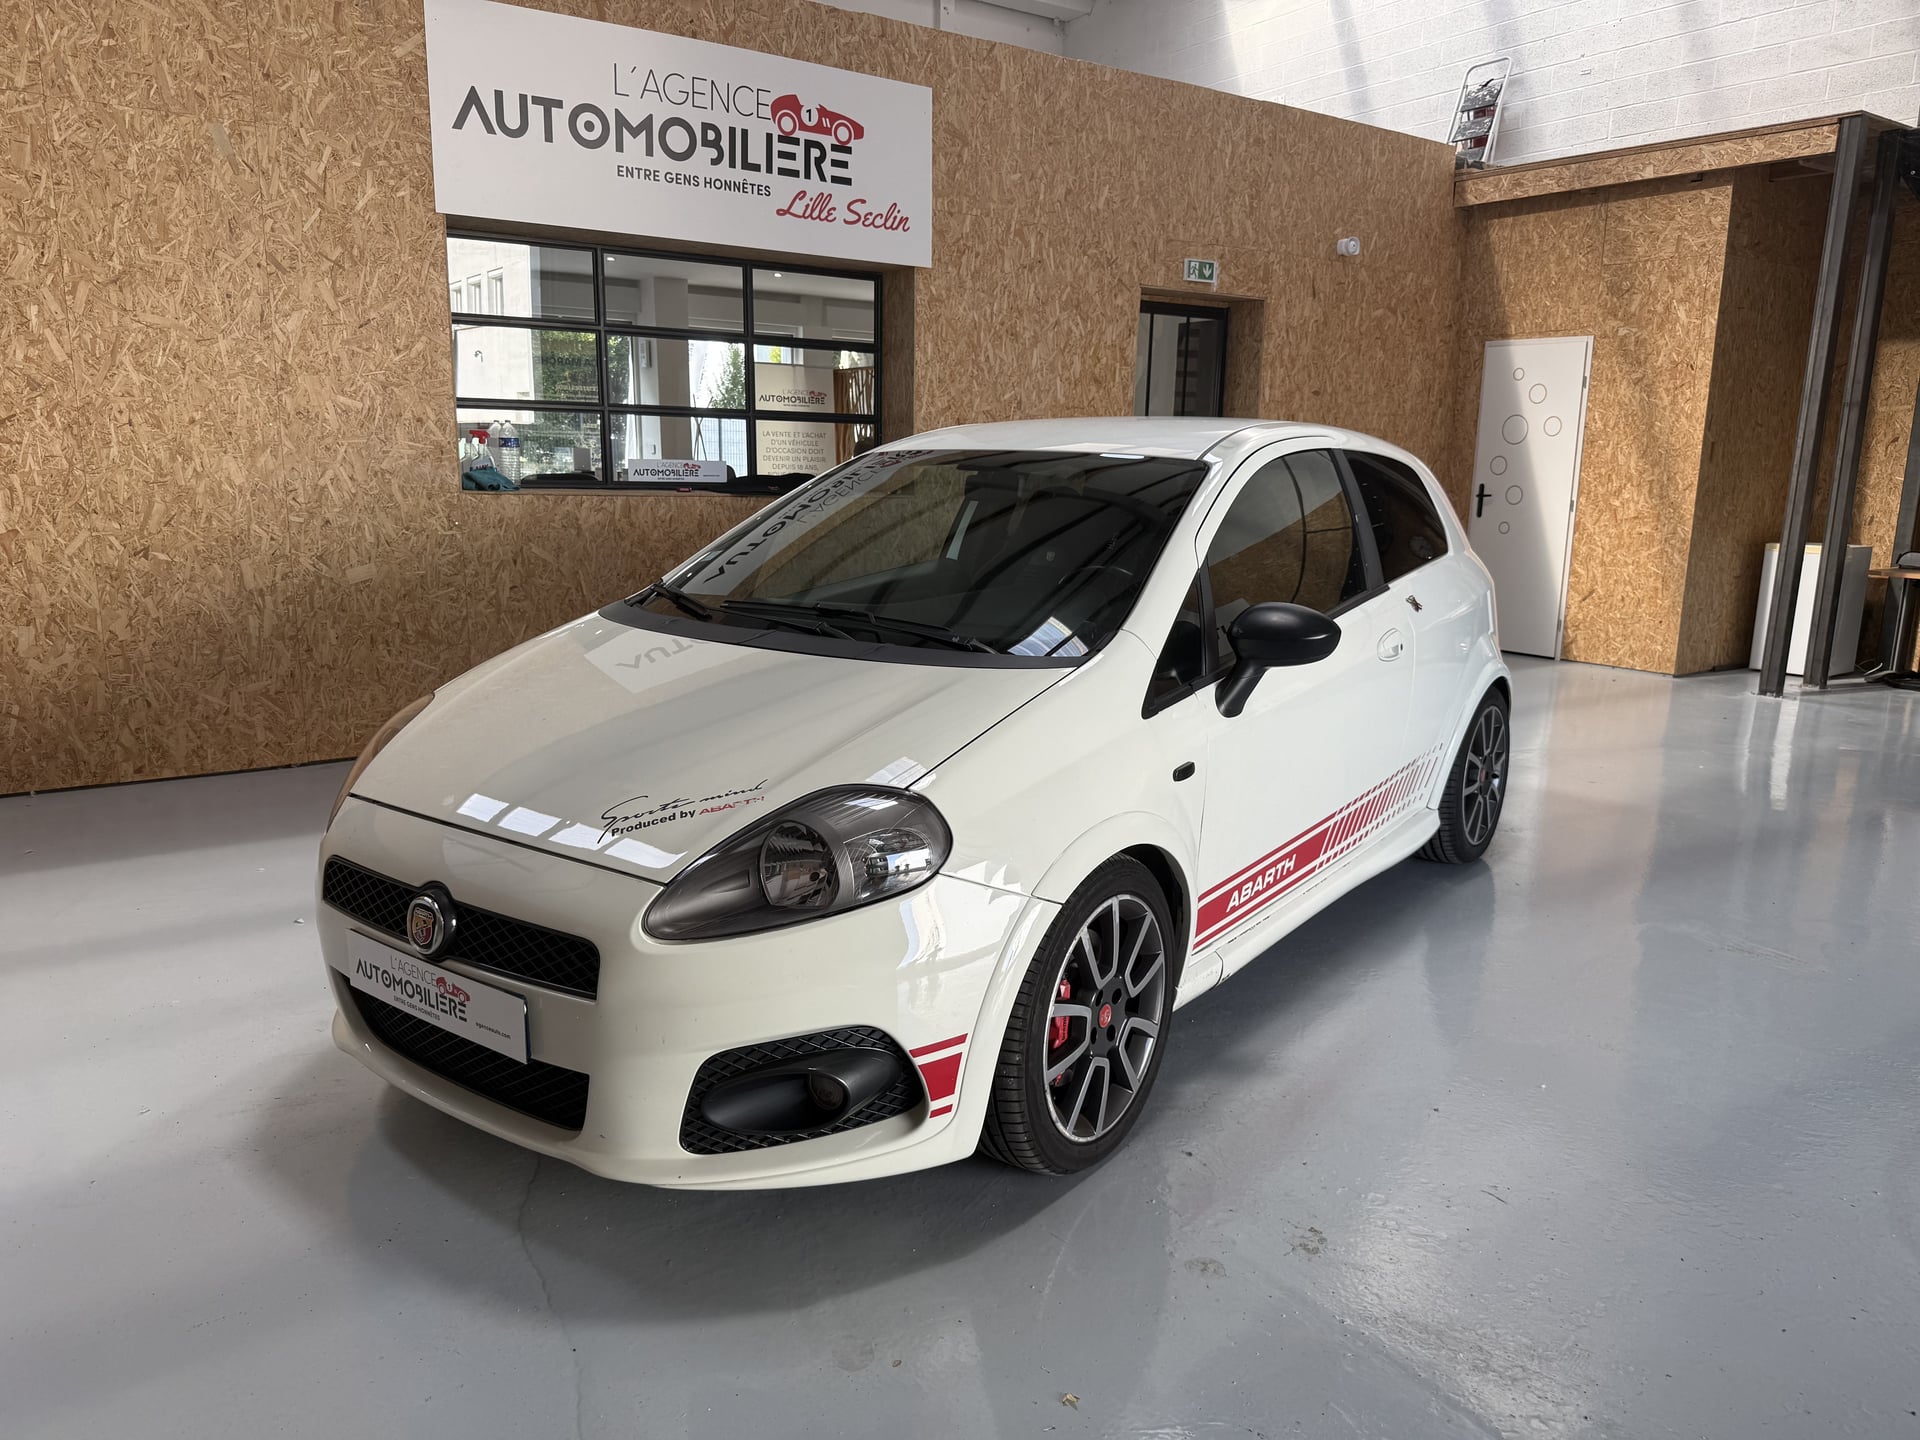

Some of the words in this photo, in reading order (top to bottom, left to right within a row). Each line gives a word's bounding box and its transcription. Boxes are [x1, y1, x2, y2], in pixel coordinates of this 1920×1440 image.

[613, 62, 772, 121] L'AGENCE
[805, 108, 812, 123] 1
[616, 164, 661, 183] ENTRE
[664, 171, 701, 188] GENS
[704, 177, 772, 198] HONNÊTES
[776, 190, 837, 223] Lille
[843, 198, 911, 233] Seclin
[611, 811, 677, 837] Produced
[680, 808, 697, 819] by
[1226, 853, 1297, 913] ABARTH
[390, 955, 437, 988] L'AGENCE
